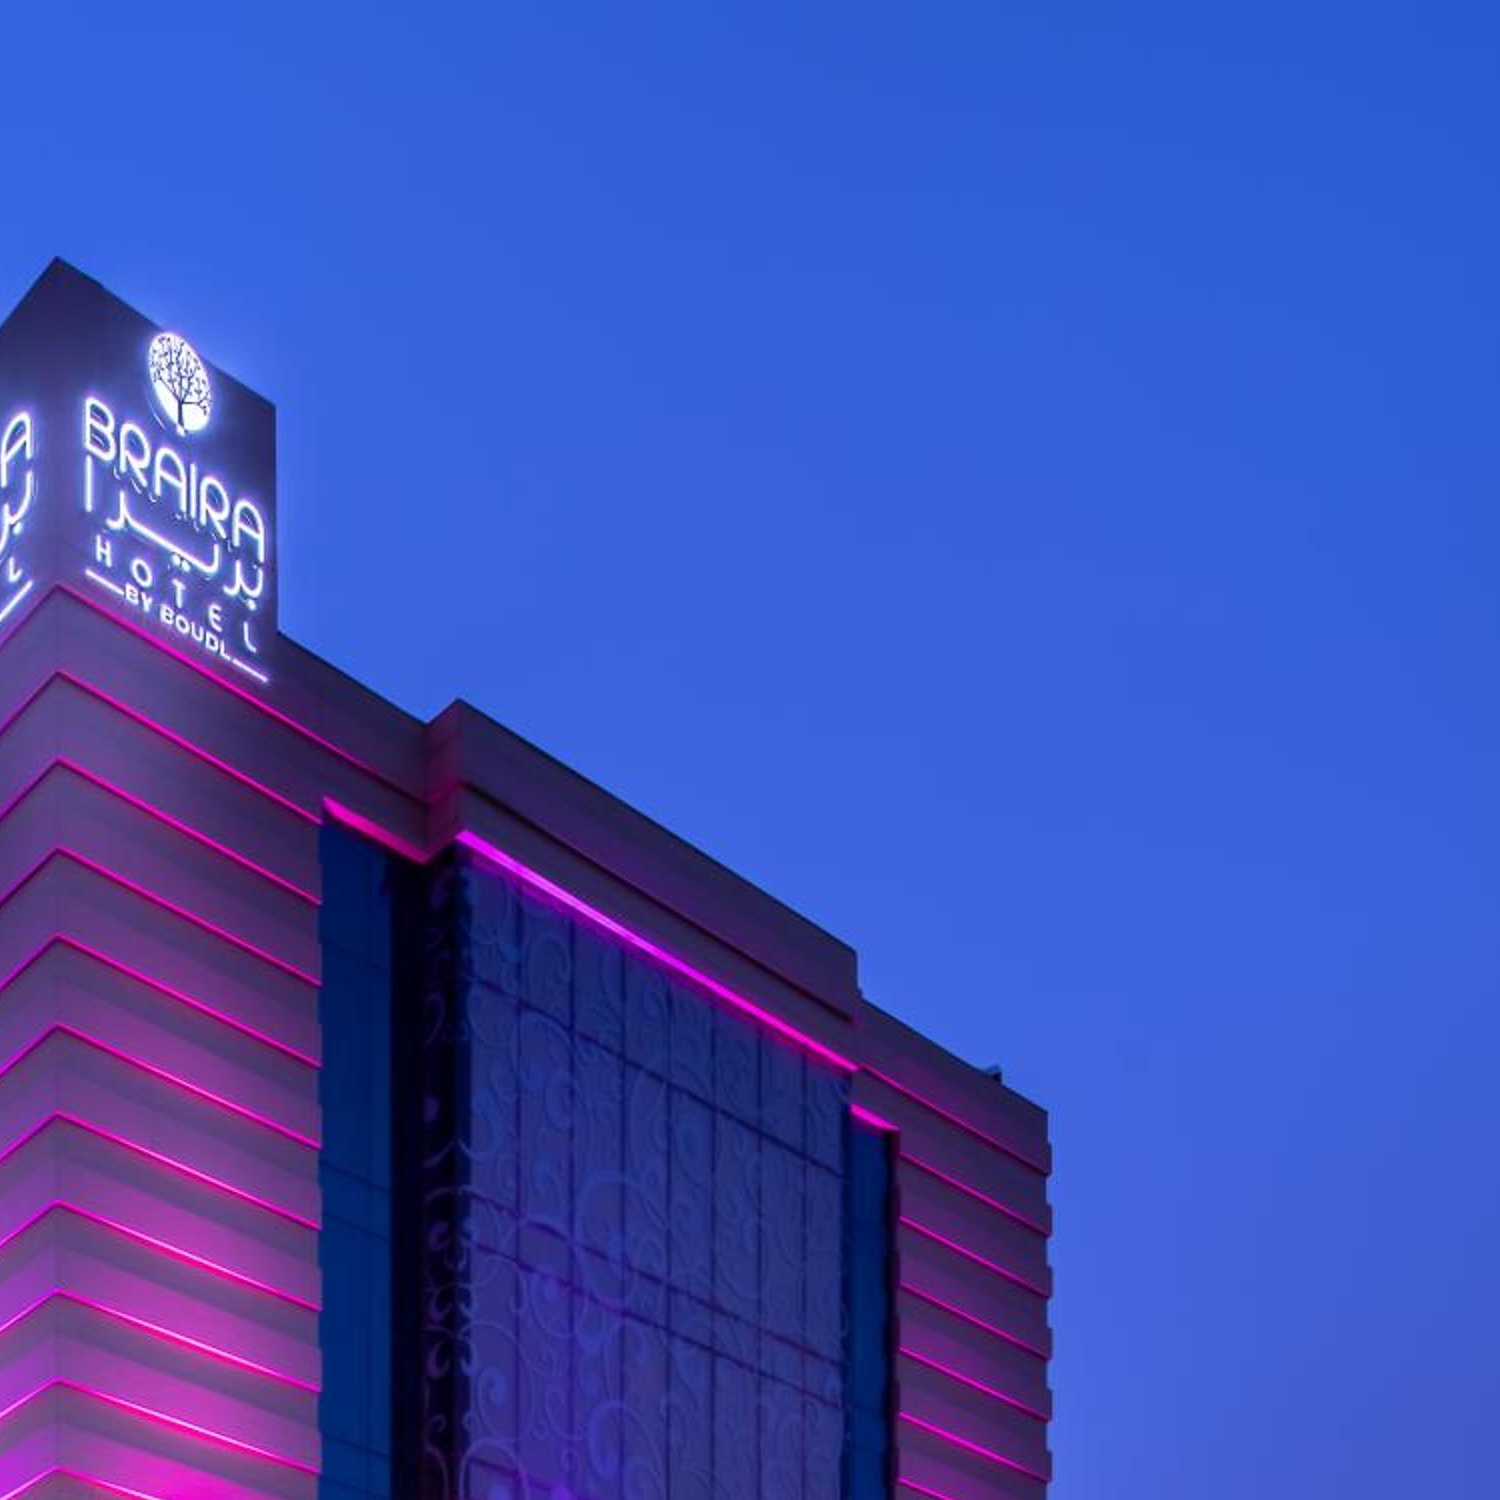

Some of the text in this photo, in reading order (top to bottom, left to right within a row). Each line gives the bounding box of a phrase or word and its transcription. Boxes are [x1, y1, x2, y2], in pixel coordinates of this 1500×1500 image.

[84, 396, 265, 564] BRAIRA
[84, 454, 264, 611] بريرا
[95, 533, 258, 654] HOTEL
[123, 582, 232, 662] BY BOUDL
